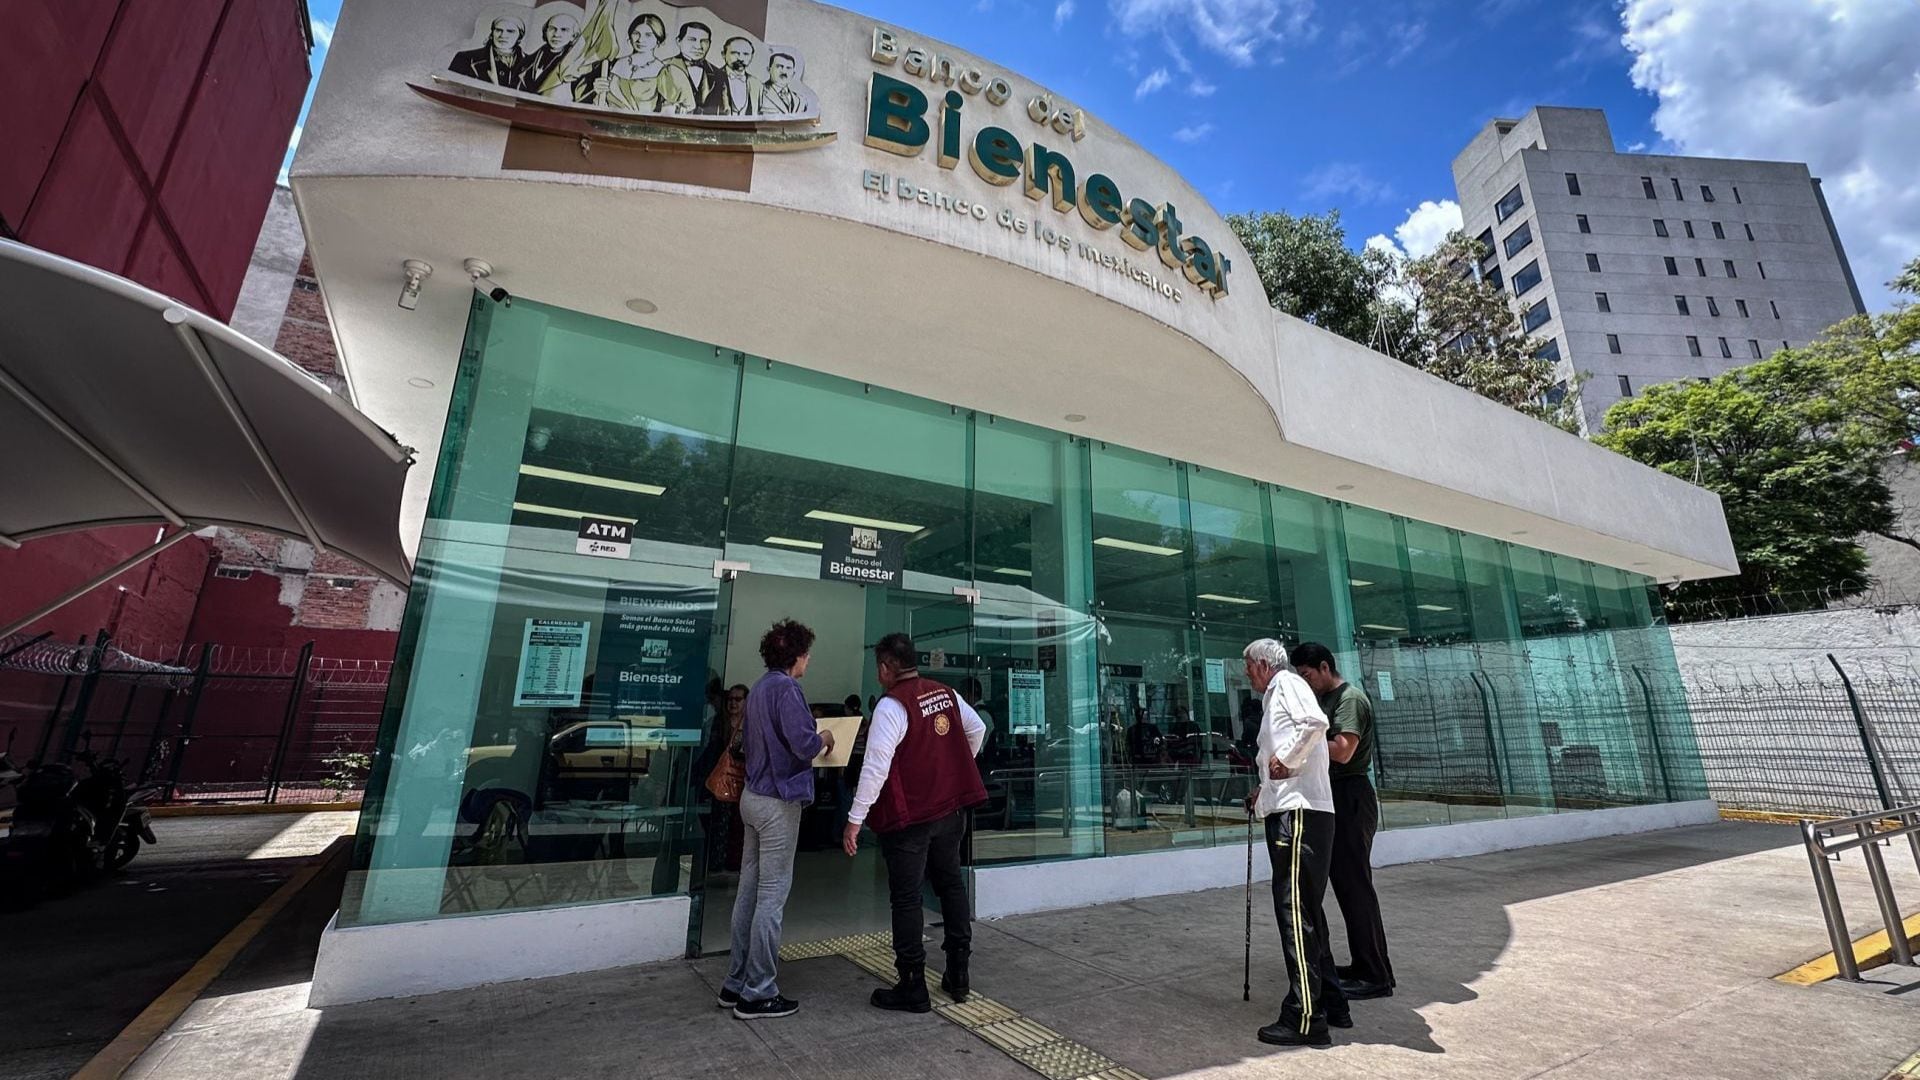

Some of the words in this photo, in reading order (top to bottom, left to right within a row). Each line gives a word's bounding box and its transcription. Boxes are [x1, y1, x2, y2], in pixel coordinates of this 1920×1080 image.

[871, 26, 1012, 106] Banco
[1027, 94, 1086, 142] del
[863, 72, 1232, 300] Bienestar
[863, 169, 891, 195] El
[897, 177, 988, 221] banco
[996, 208, 1028, 234] de
[1034, 220, 1072, 253] los
[1078, 242, 1183, 302] mexicanos
[586, 522, 626, 538] ATM
[600, 545, 617, 553] RED
[845, 555, 869, 566] Banco
[870, 559, 882, 567] del
[830, 561, 895, 580] Bienestar
[620, 596, 701, 611] BIENVENIDOS
[621, 613, 644, 622] Somos
[652, 616, 674, 624] Banco
[674, 618, 696, 626] Social
[619, 622, 635, 630] más
[635, 623, 661, 632] grande
[671, 625, 696, 634] México
[619, 671, 683, 684] Bienestar
[921, 699, 954, 718] MÉXICO
